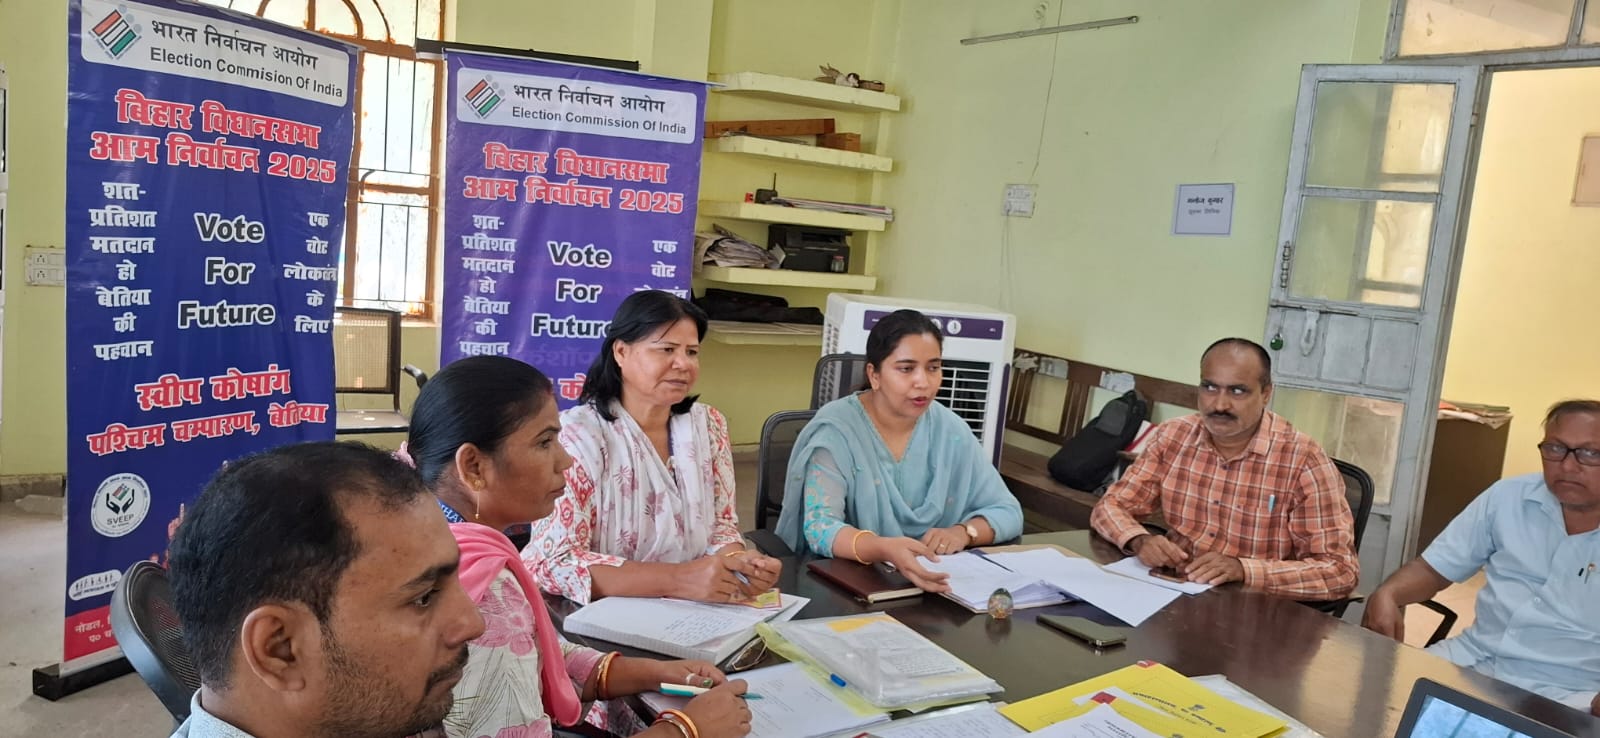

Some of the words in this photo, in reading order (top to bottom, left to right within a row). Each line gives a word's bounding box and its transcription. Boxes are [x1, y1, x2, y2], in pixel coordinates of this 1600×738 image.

[151, 20, 196, 44] भारत
[204, 25, 267, 56] निर्वाचन
[273, 46, 318, 70] आयोग
[150, 47, 212, 70] Election
[296, 75, 310, 89] Of
[313, 80, 343, 98] India
[514, 84, 552, 101] भारत
[559, 85, 614, 108] निर्वाचन
[620, 94, 665, 113] आयोग
[115, 88, 194, 131] बिहार
[512, 106, 561, 122] Election
[565, 112, 639, 130] Commission
[643, 118, 656, 130] Of
[659, 119, 687, 135] India
[90, 132, 160, 164] आम
[166, 132, 260, 174] निर्वाचन
[267, 153, 337, 183] 2025
[483, 142, 549, 173] बिहार
[102, 182, 146, 200] शत-
[463, 175, 518, 201] आम
[524, 176, 612, 208] निर्वाचन
[619, 189, 684, 214] 2025
[88, 205, 157, 228] प्रतिशत
[307, 211, 330, 228] एक
[194, 212, 265, 243] Vote
[89, 236, 155, 254] मतदान
[306, 236, 328, 254] वोट
[462, 234, 517, 252] प्रतिशत
[652, 239, 678, 254] एक
[462, 256, 515, 274] मतदान
[547, 241, 612, 268] Vote
[116, 259, 137, 280] हो
[205, 257, 255, 285] For
[650, 262, 676, 278] वोट
[479, 276, 497, 294] हो
[555, 277, 602, 303] For
[96, 286, 152, 307] बेतिया
[306, 289, 325, 307] के
[463, 297, 510, 315] बेतिया
[113, 312, 137, 333] की
[178, 299, 275, 329] Future
[294, 315, 331, 333] लिए
[474, 317, 498, 335] की
[459, 341, 510, 356] पहचान
[135, 373, 204, 411] स्वीप
[210, 364, 291, 401] कोषांग
[87, 423, 166, 456] पश्चिम
[172, 411, 261, 443] चम्पारण,
[268, 400, 329, 427] बेतिया
[107, 513, 134, 526] SVEEP
